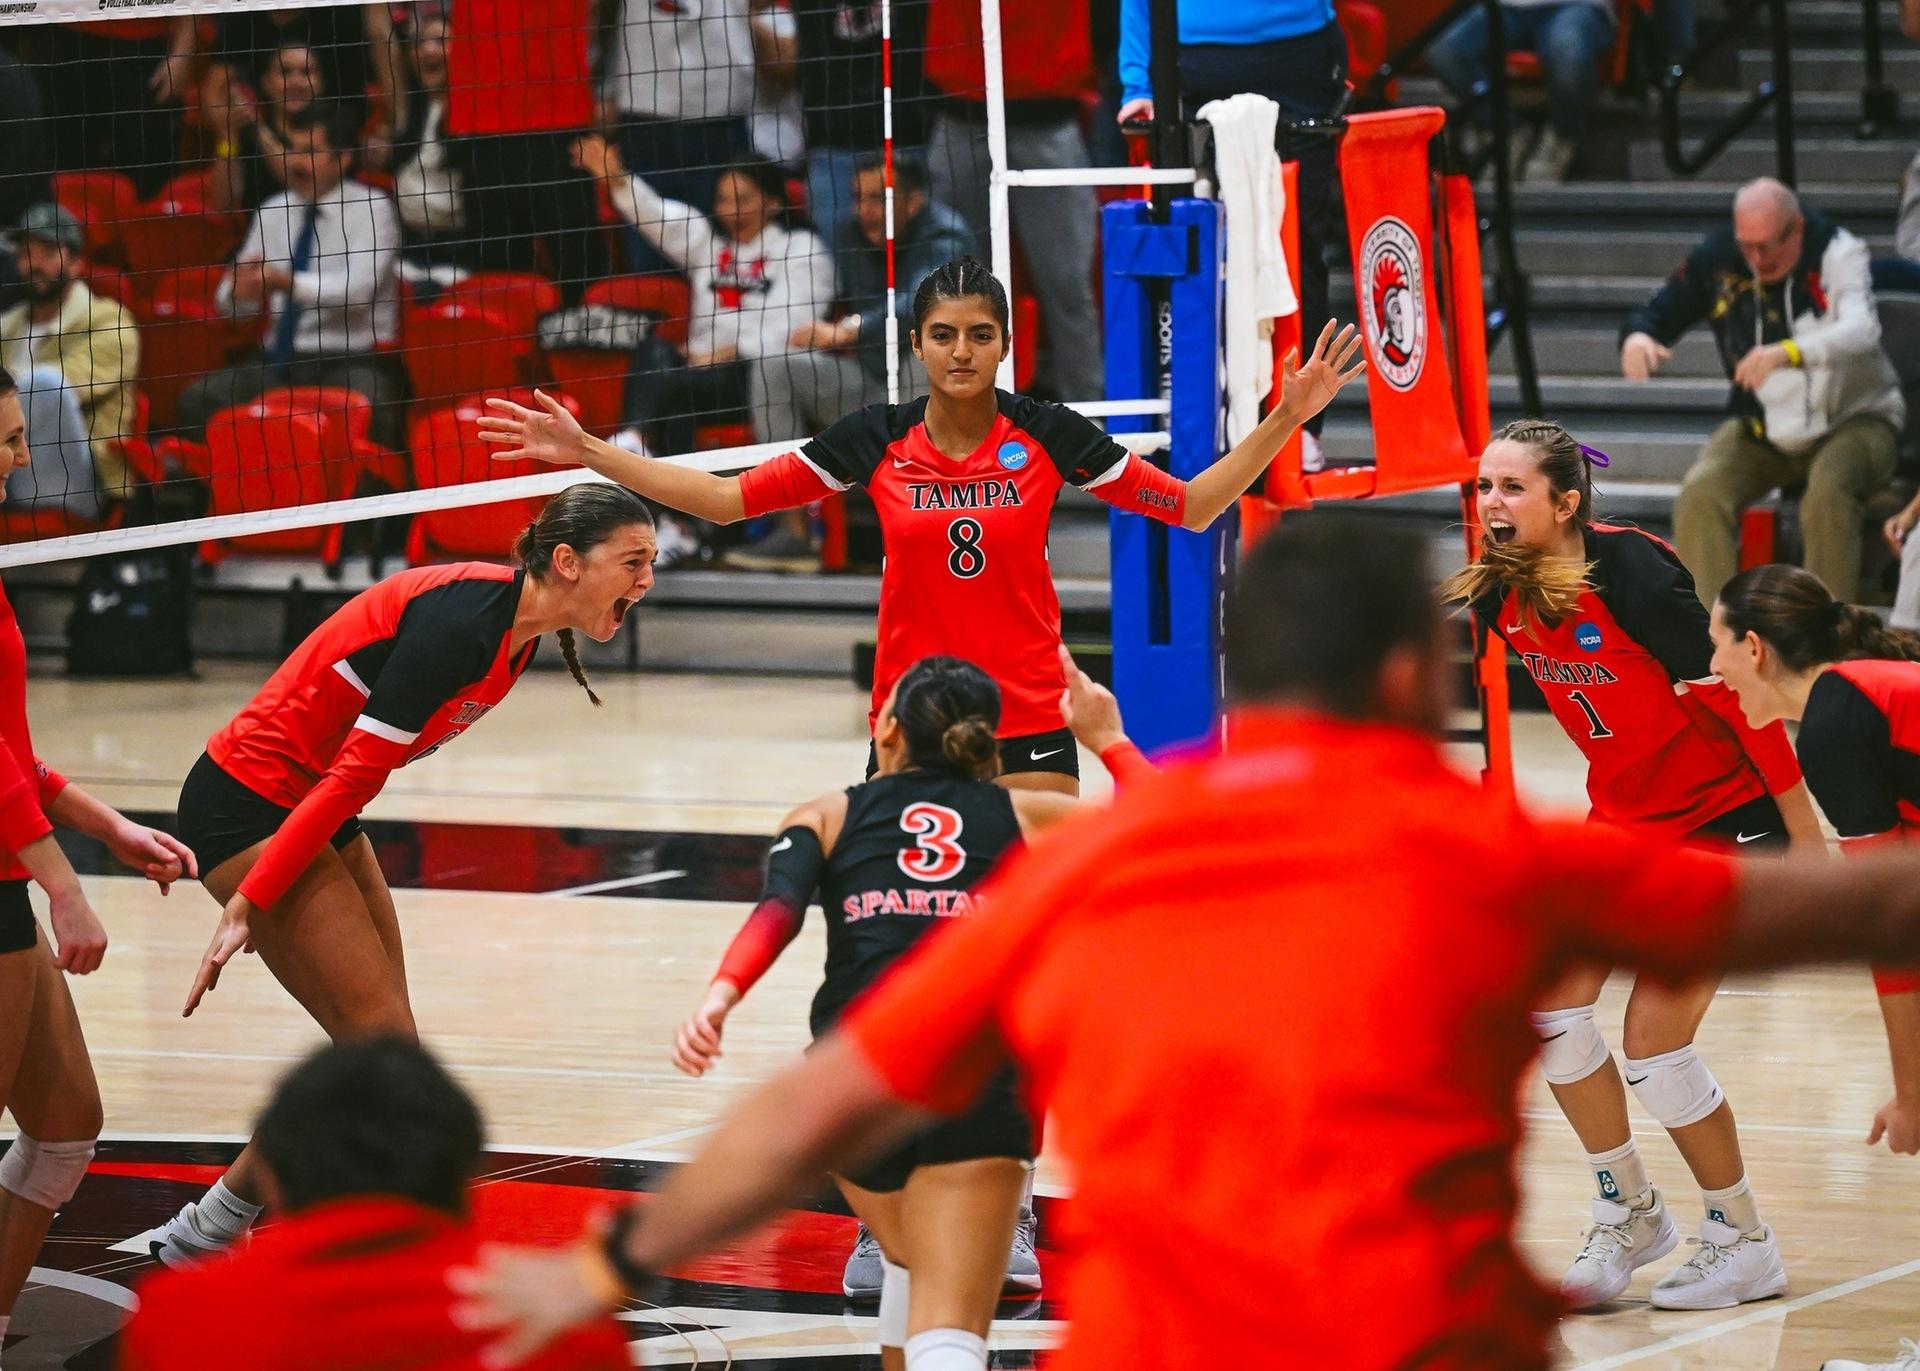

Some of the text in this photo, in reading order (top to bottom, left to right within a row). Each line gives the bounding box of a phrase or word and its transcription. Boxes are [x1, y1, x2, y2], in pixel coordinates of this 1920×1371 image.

[0, 2, 37, 14] HAMPIONSHIP
[1003, 450, 1028, 466] NCAA
[906, 479, 1024, 511] TAMPA
[947, 516, 986, 580] 8
[1579, 635, 1602, 646] NCAA
[1522, 652, 1619, 685] TAMPA
[1567, 690, 1614, 739] 1
[897, 801, 967, 883] 3
